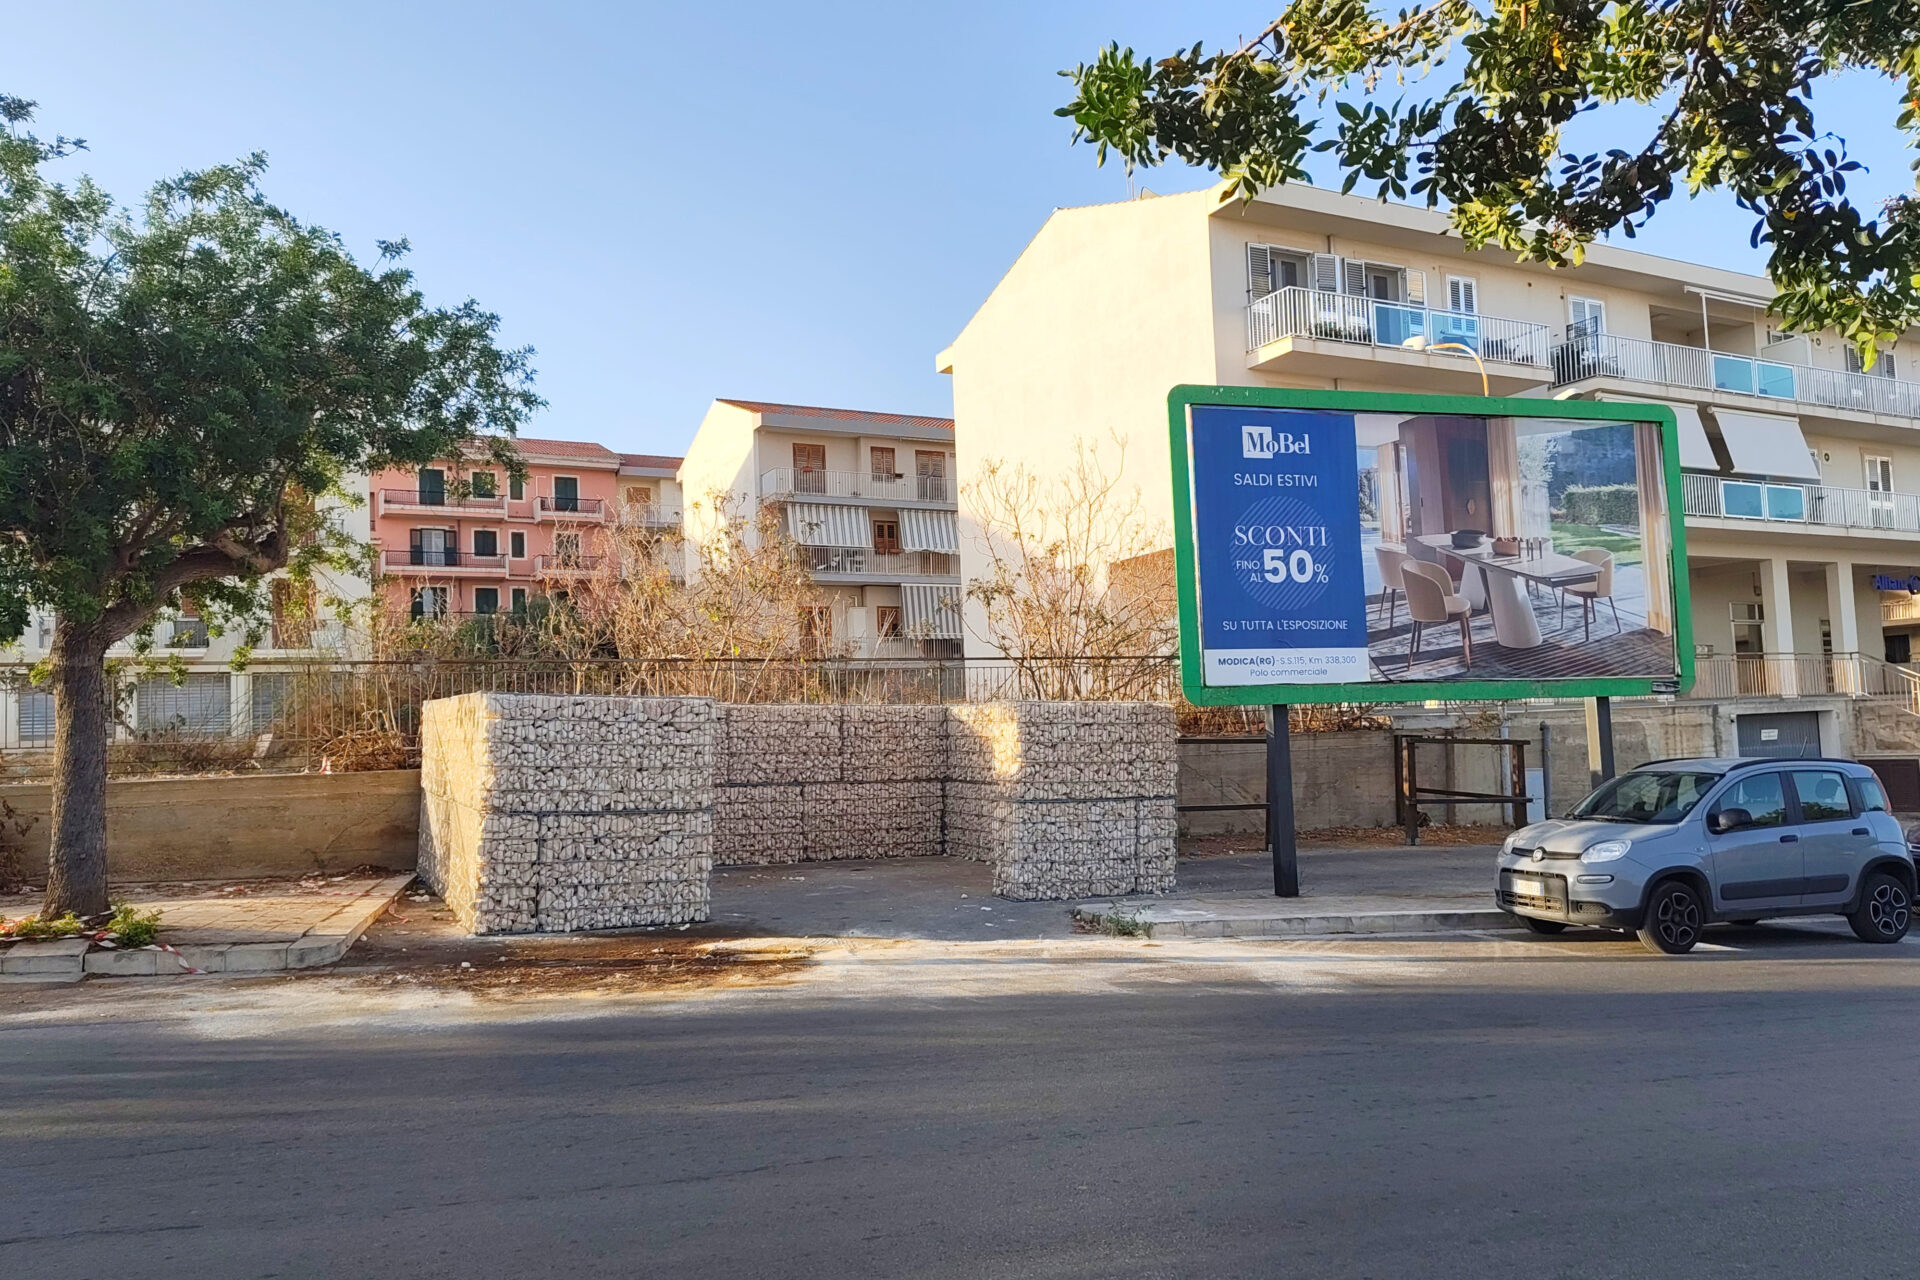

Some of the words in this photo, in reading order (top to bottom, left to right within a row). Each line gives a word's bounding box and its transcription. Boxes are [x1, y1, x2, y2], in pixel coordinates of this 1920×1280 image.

[1245, 431, 1312, 455] MoBel
[1234, 473, 1273, 486] SALDI
[1277, 474, 1318, 487] ESTIVI
[1234, 525, 1328, 547] SCONTI
[1236, 560, 1260, 570] FINO
[1263, 549, 1329, 584] 50%
[1250, 572, 1263, 583] AL
[1222, 620, 1238, 631] SU
[1240, 620, 1274, 631] TUTTA
[1277, 619, 1348, 630] L'ESPOSIZIONE
[1309, 655, 1323, 665] Km
[1250, 668, 1269, 677] Polo
[1270, 667, 1328, 676] commerciale
